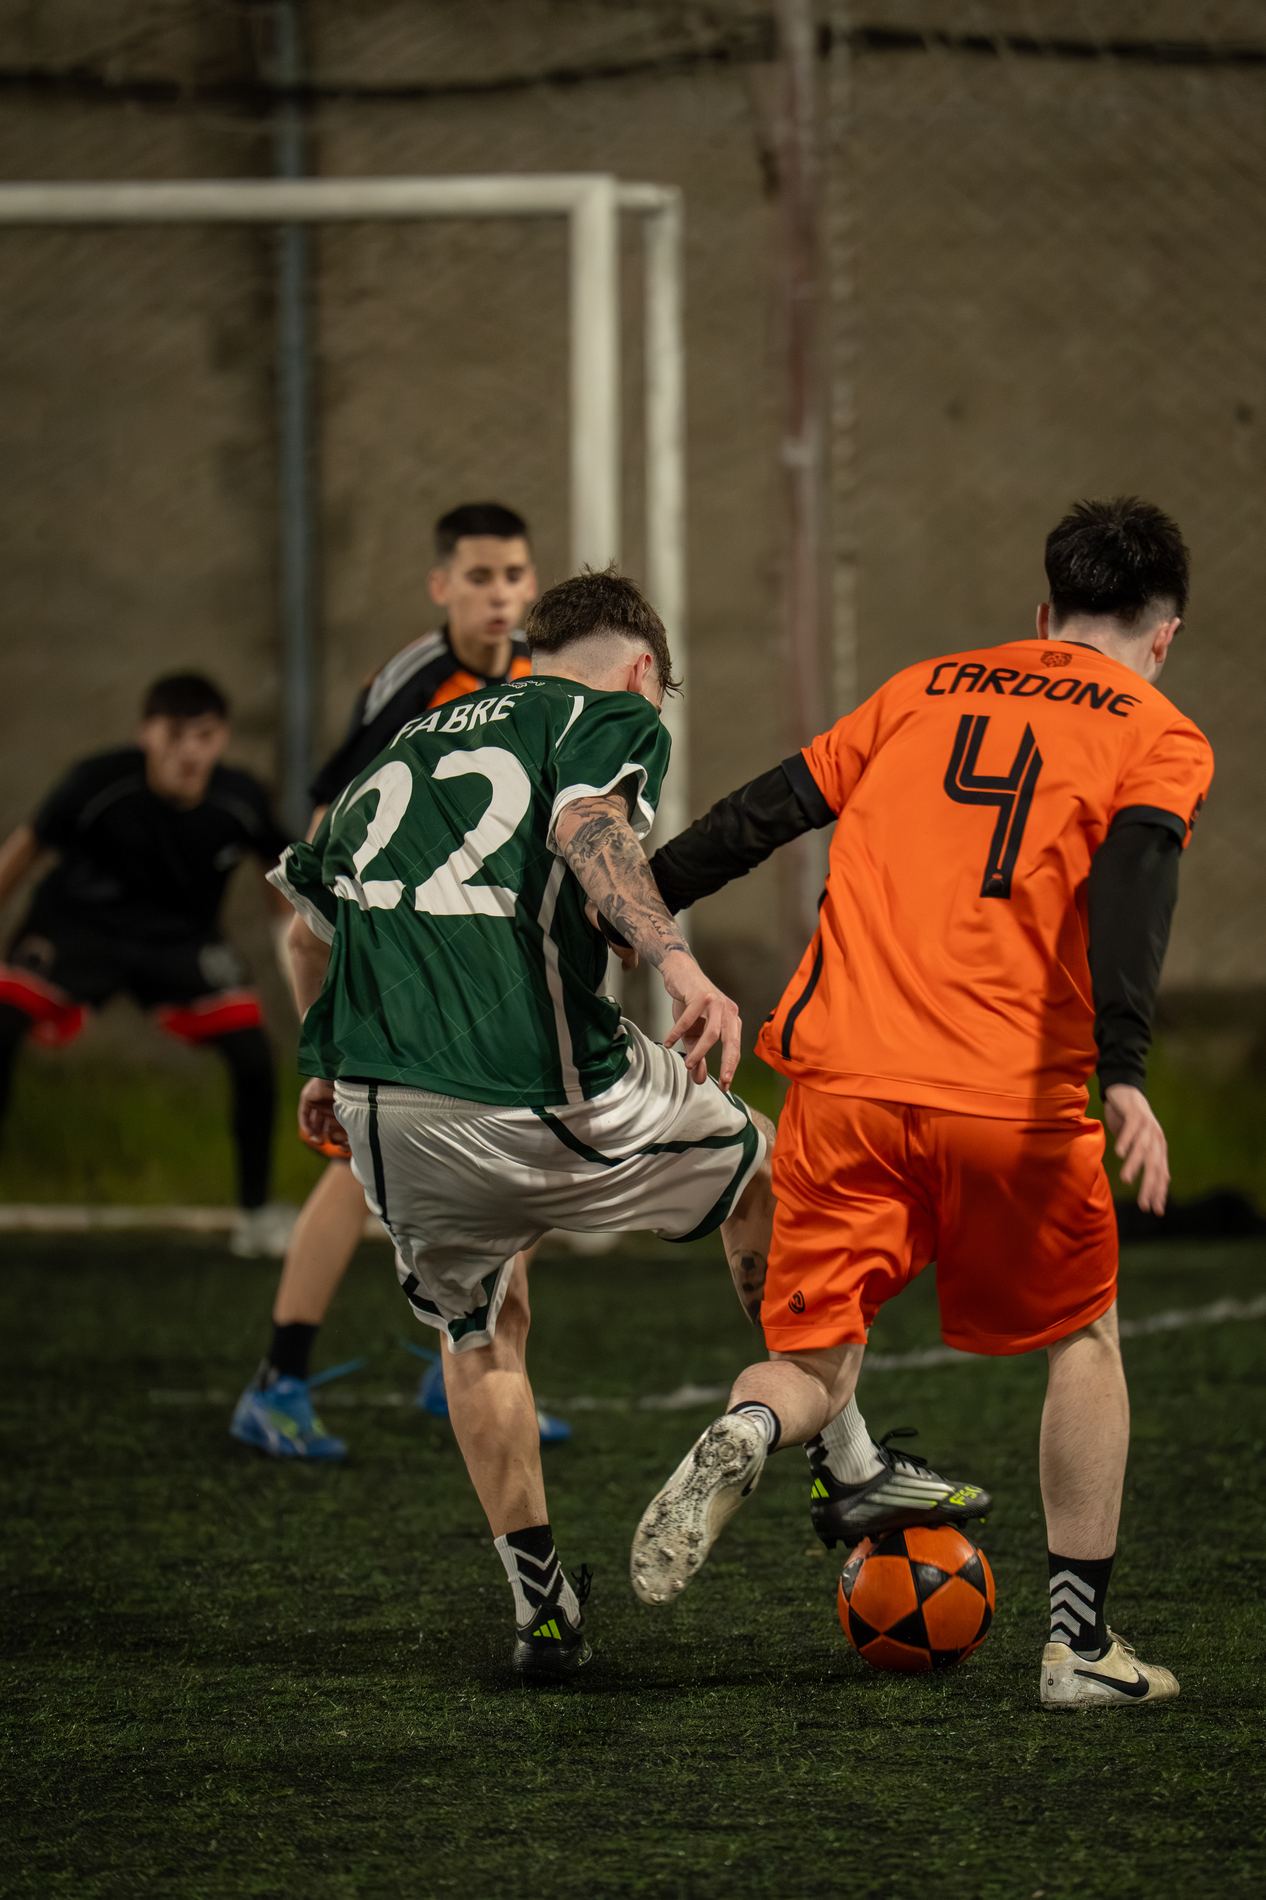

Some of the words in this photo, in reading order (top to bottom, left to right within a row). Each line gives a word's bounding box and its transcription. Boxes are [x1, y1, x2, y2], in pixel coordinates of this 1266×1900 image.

[389, 692, 525, 750] FABRE
[925, 662, 1142, 717] CARDONE
[332, 746, 531, 917] 22
[943, 714, 1043, 900] 4
